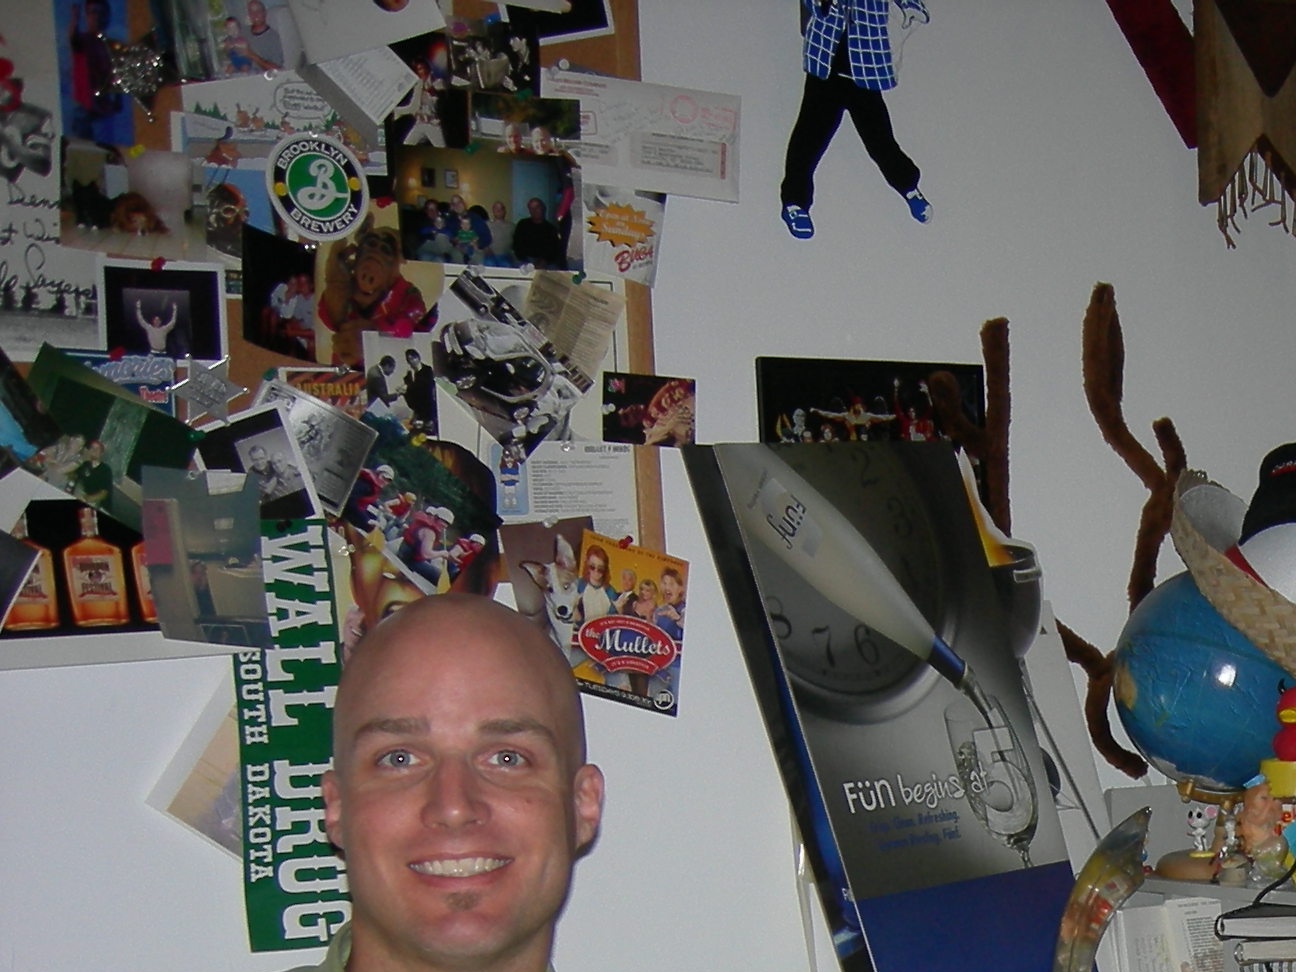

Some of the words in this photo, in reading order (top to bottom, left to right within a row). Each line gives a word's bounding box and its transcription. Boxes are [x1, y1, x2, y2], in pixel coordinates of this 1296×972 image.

[277, 141, 348, 170] BROOKLYN
[290, 204, 358, 233] BREWERY
[260, 524, 338, 728] WALL
[596, 629, 670, 657] Mullets
[238, 651, 268, 745] SOUTH
[896, 773, 966, 809] begins
[969, 761, 991, 793] at
[246, 763, 273, 883] DAKOTA
[273, 756, 354, 943] DRUG
